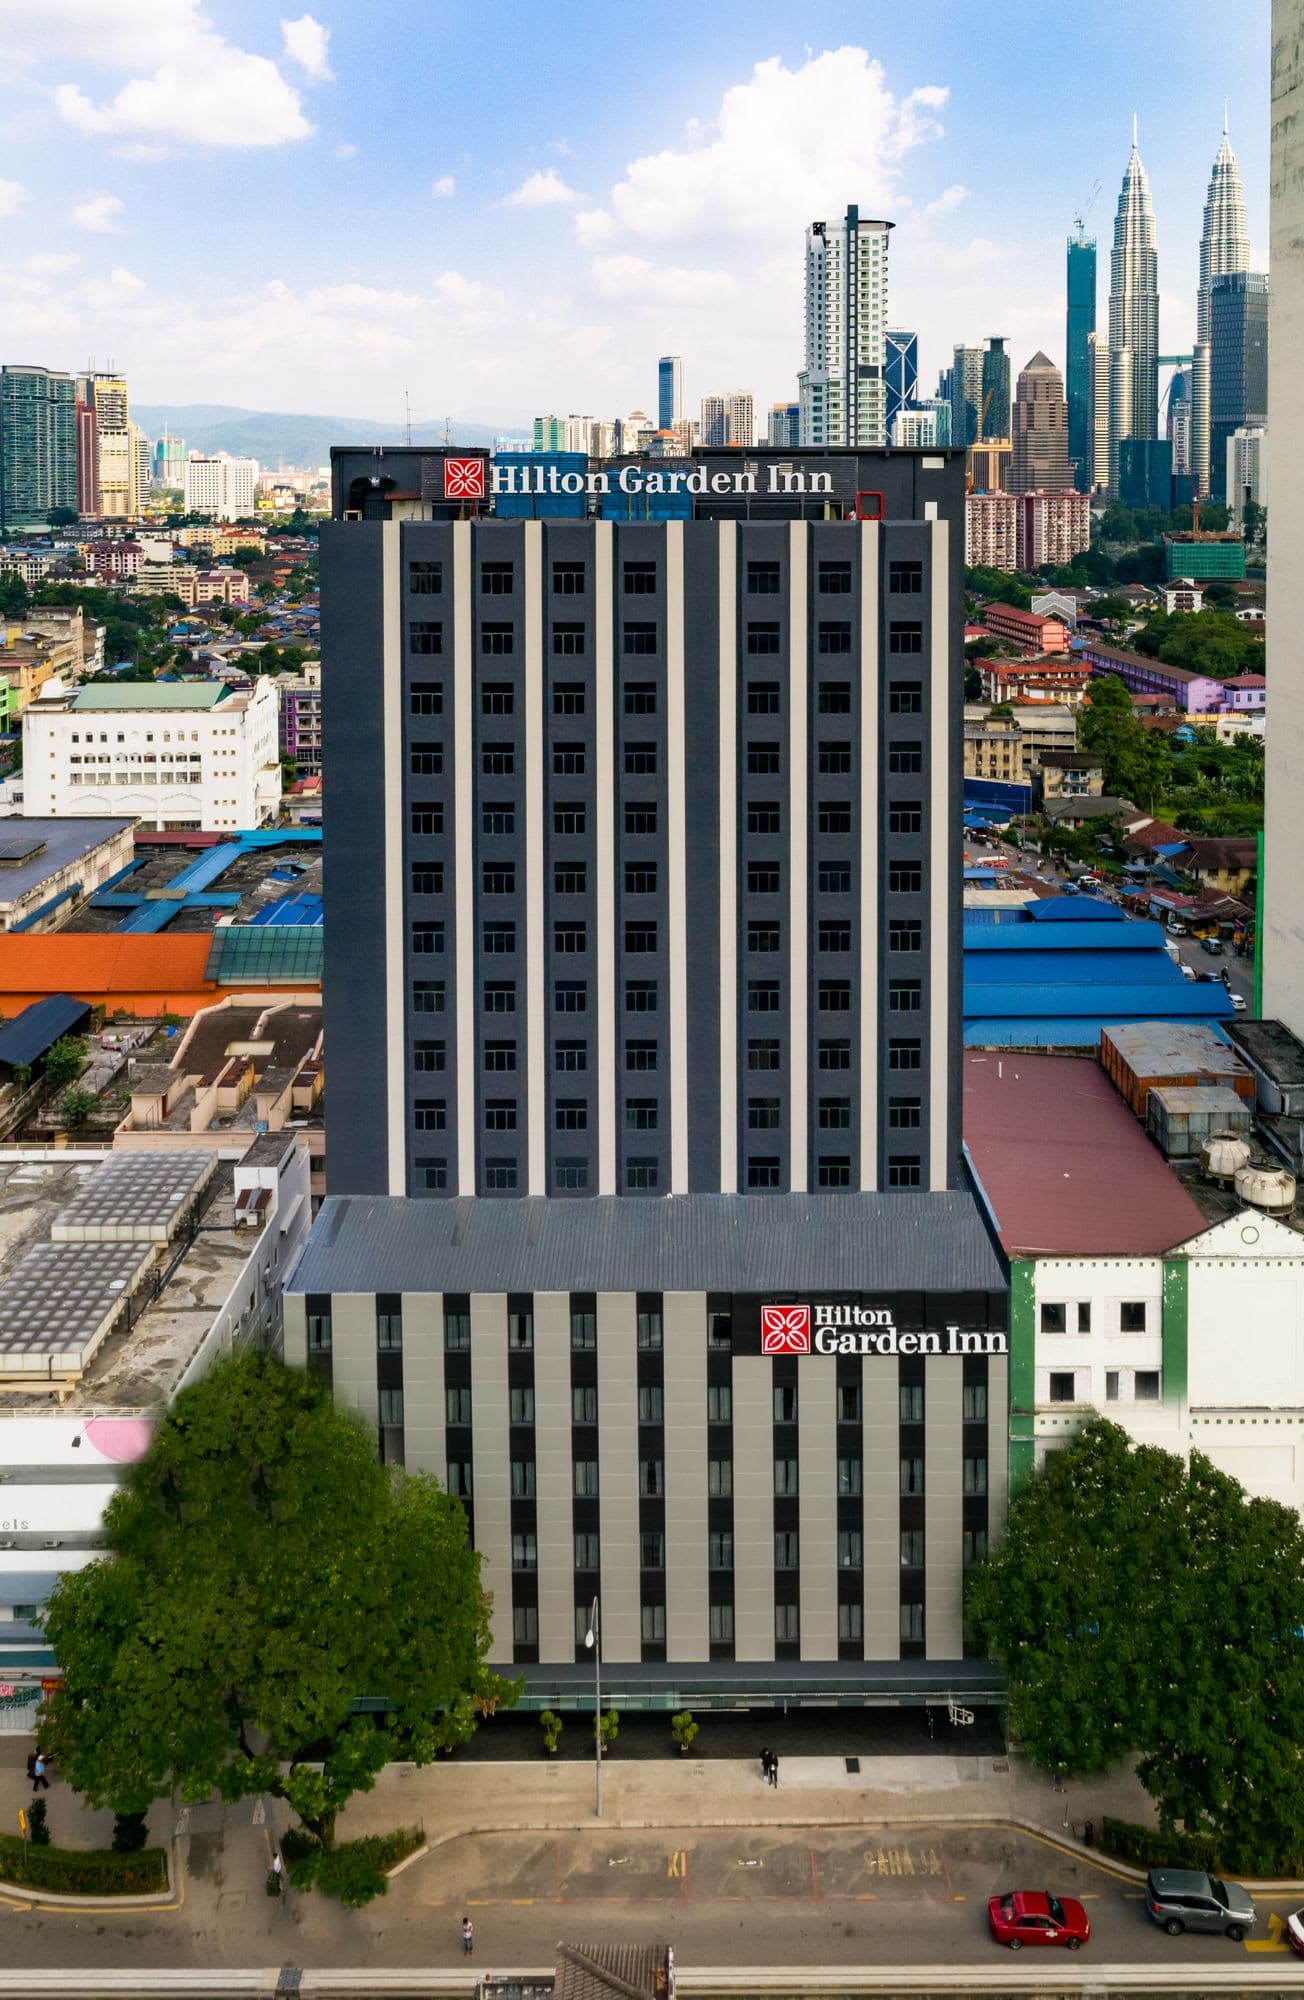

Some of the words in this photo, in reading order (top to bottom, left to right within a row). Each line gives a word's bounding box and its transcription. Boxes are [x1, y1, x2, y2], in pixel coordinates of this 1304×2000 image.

[490, 465, 610, 494] Hilton
[619, 465, 757, 494] Garden
[766, 465, 834, 494] Inn
[814, 1305, 893, 1326] Hilton
[815, 1327, 942, 1354] Garden
[946, 1326, 1009, 1354] Inn
